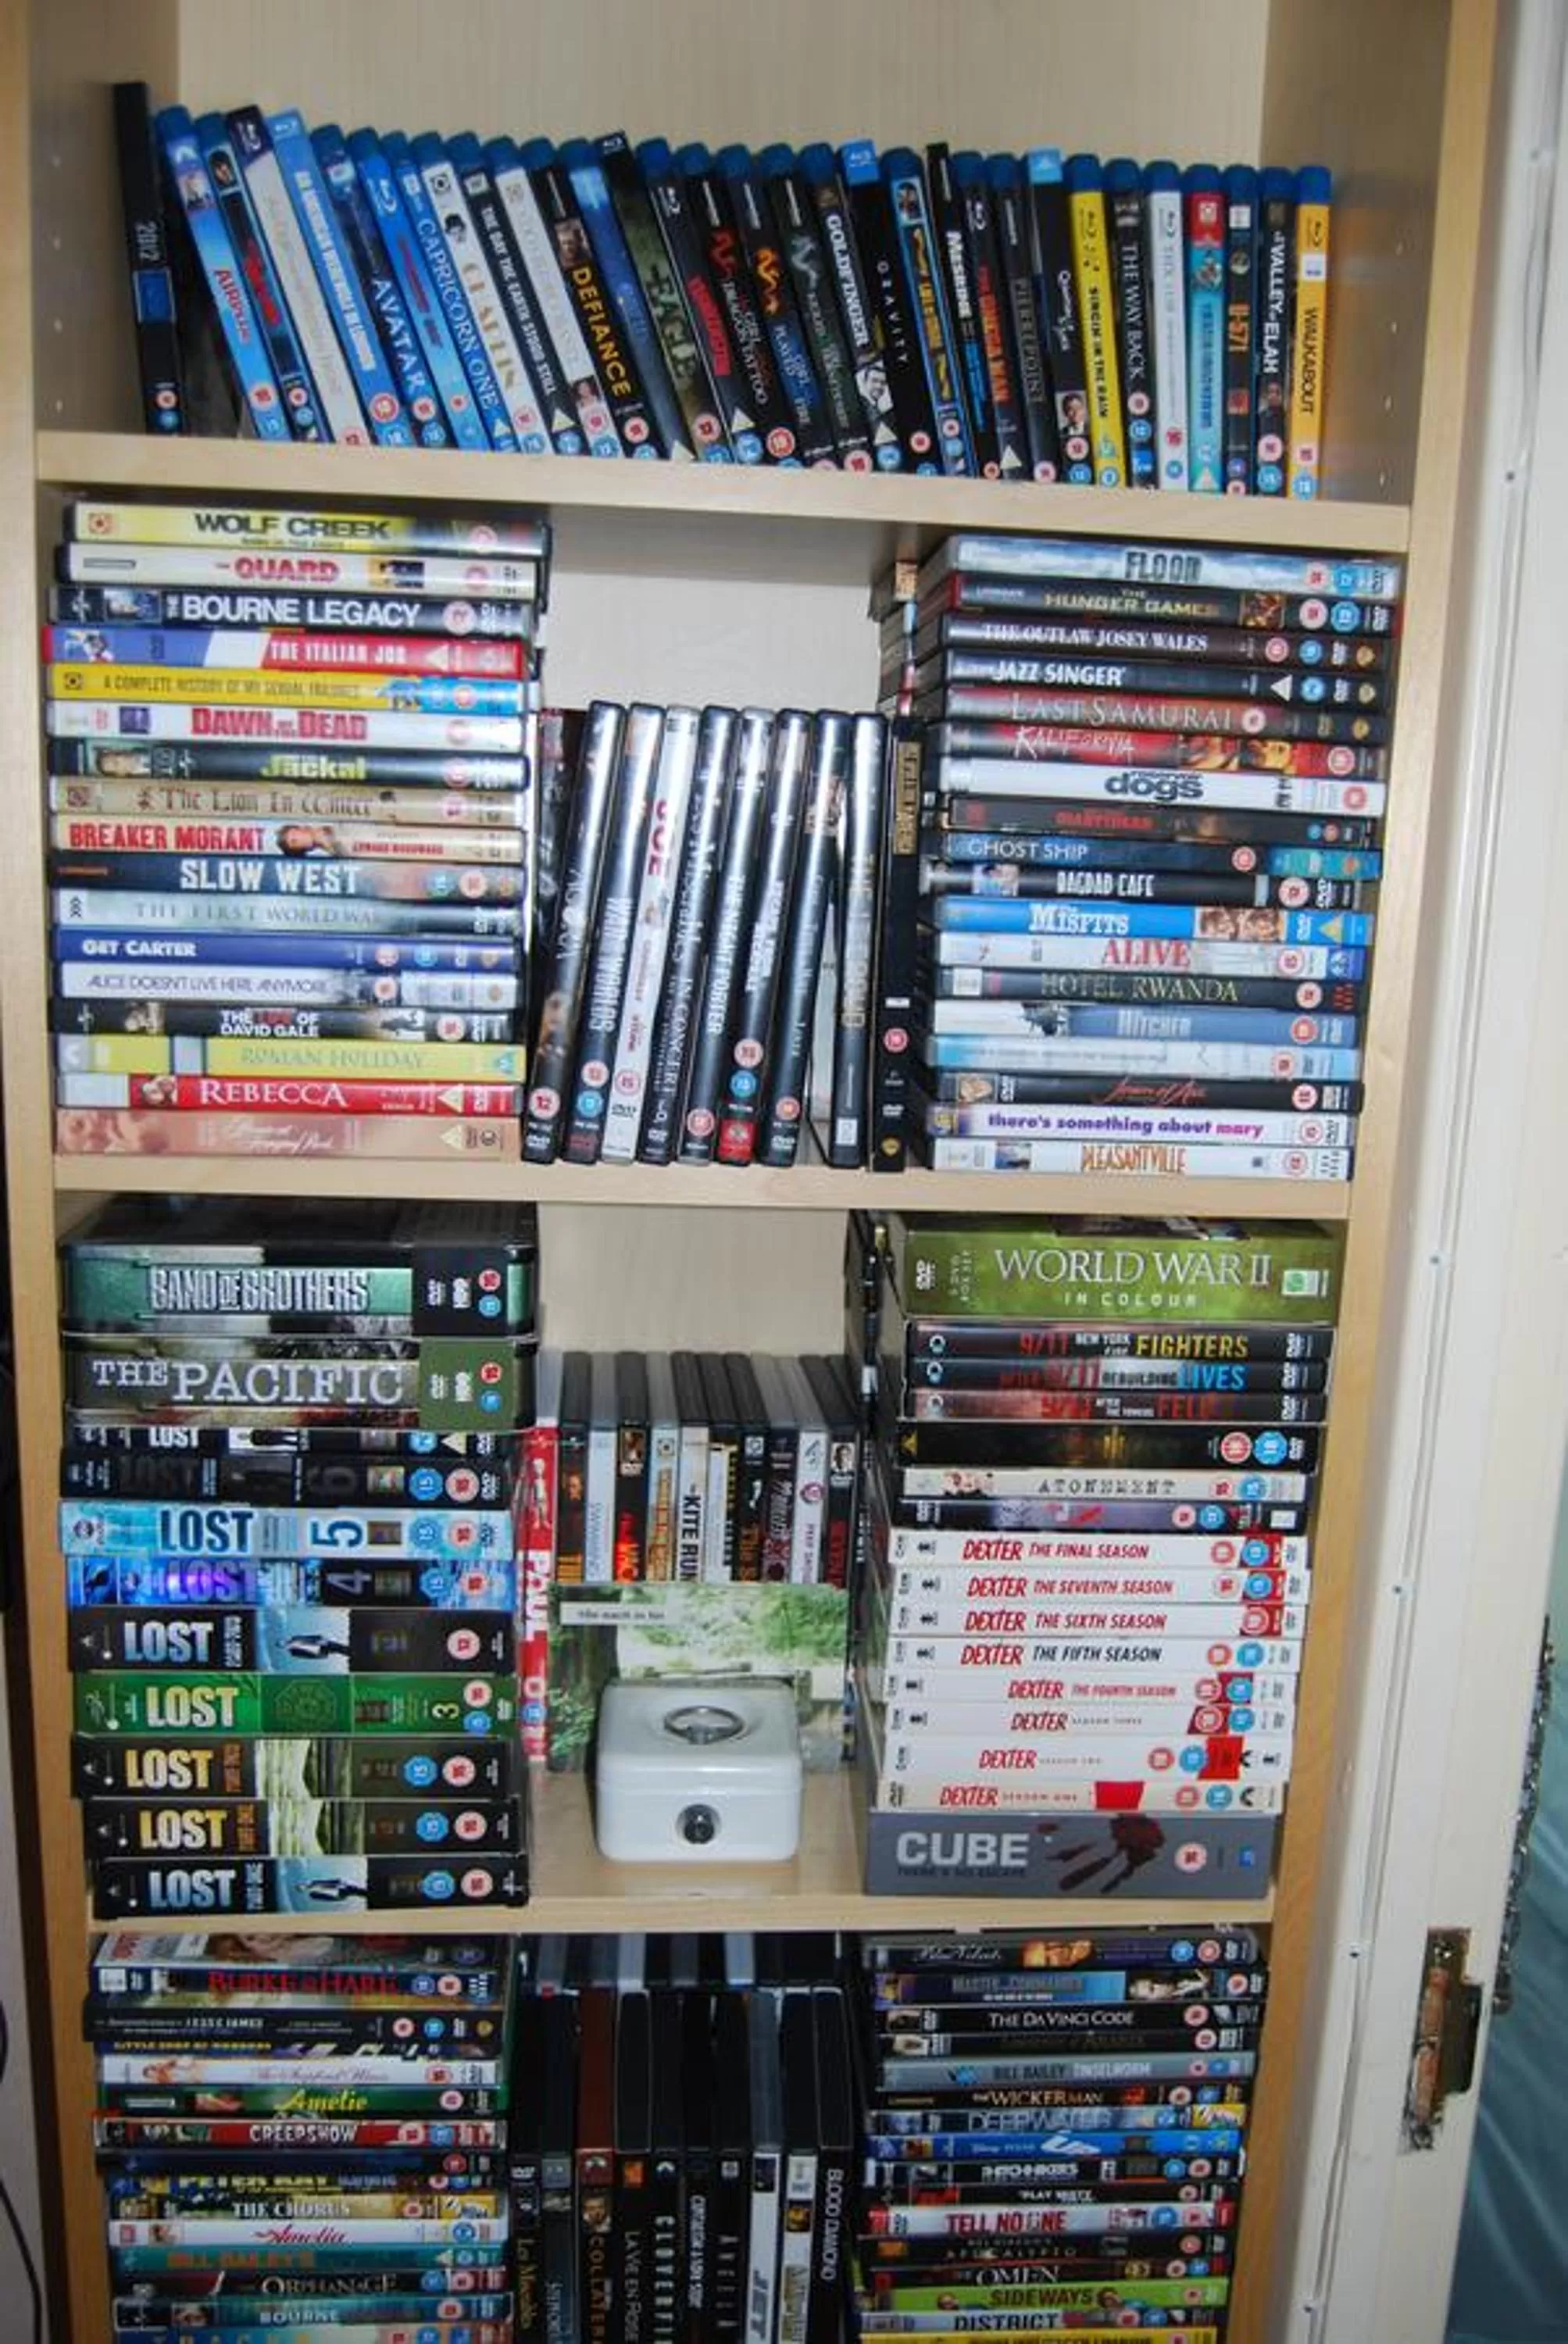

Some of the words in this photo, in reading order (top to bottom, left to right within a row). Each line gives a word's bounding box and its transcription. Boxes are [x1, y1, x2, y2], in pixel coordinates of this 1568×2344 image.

[1123, 245, 1138, 277] THE
[827, 214, 870, 347] GOLDFINGER
[1267, 242, 1286, 313] VALLEY
[416, 219, 479, 352] CAPRICORN
[469, 358, 501, 409] ONE
[877, 261, 908, 363] GRAVITY
[1125, 284, 1142, 325] WAY
[372, 278, 426, 392] AVATAR
[573, 267, 631, 397] DEFIANCE
[1127, 329, 1145, 381] BACK
[1263, 320, 1280, 373] ELAH
[1300, 307, 1320, 415] WALKABOUT
[195, 513, 280, 536] WOLF
[286, 517, 391, 538] CREEK
[235, 557, 340, 583] GUARD
[1125, 548, 1203, 582] FLOOD
[182, 595, 299, 622] BOURNE
[307, 600, 420, 628] LEGACY
[1044, 593, 1138, 613] HUNGER
[1145, 598, 1220, 617] GAMES
[270, 640, 301, 660] THE
[306, 641, 369, 663] ITALIAN
[373, 644, 407, 665] JOB
[1096, 630, 1148, 649] JOSEY
[1152, 632, 1209, 652] WALES
[114, 675, 171, 692] COMPLETE
[991, 661, 1040, 681] JAZZ
[1044, 664, 1123, 686] SINGER
[192, 708, 273, 736] DAWN
[298, 710, 367, 740] DEAD
[1011, 693, 1085, 720] LAST
[1089, 695, 1232, 731] SAMURAI
[261, 753, 366, 780] Jackal
[1105, 771, 1204, 801] dogs
[70, 823, 166, 850] BREAKER
[175, 825, 264, 852] MORANT
[968, 838, 1038, 859] GHOST
[1043, 841, 1090, 861] SHIP
[180, 860, 265, 892] SLOW
[273, 862, 362, 895] WEST
[1056, 870, 1113, 895] BAGDAD
[136, 902, 180, 920] THE
[190, 903, 256, 922] FIRST
[266, 906, 341, 924] WORLD
[83, 940, 121, 956] GET
[126, 940, 196, 958] CARTER
[1101, 938, 1192, 968] ALIVE
[86, 975, 125, 991] ALICE
[191, 976, 216, 992] LIVE
[218, 977, 253, 992] HERE
[1040, 972, 1123, 999] HOTEL
[1132, 974, 1241, 1002] RWANDA
[705, 967, 735, 1035] PORTER
[221, 1010, 249, 1024] THE
[296, 1012, 319, 1025] OF
[221, 1024, 270, 1038] DAVID
[275, 1024, 319, 1038] GALE
[329, 1049, 426, 1068] HOLIDAY
[664, 999, 691, 1095] CONCERT
[199, 1083, 348, 1108] REBECCA
[988, 1114, 1052, 1130] there's
[1056, 1115, 1154, 1135] something
[1158, 1117, 1213, 1134] about
[1216, 1121, 1264, 1139] mary
[1080, 1144, 1185, 1172] PLEASANTVILLE
[995, 1249, 1145, 1284] WORLD
[1155, 1251, 1241, 1284] WAR
[1250, 1254, 1272, 1284] II
[151, 1270, 217, 1311] BAND
[240, 1270, 370, 1313] BROTHERS
[1065, 1292, 1089, 1304] IN
[1102, 1292, 1199, 1307] COLOUR
[1076, 1333, 1099, 1345] NEW
[1103, 1333, 1130, 1345] YORK
[1136, 1335, 1248, 1358] FIGHTERS
[93, 1360, 169, 1387] THE
[171, 1362, 405, 1405] PACIFIC
[1177, 1364, 1246, 1390] LIVES
[148, 1427, 201, 1449] LOST
[1038, 1478, 1176, 1497] ATONEMENT
[681, 1495, 702, 1540] KITE
[161, 1510, 254, 1553] LOST
[313, 1519, 363, 1547] 5
[962, 1540, 1022, 1561] DEXTER
[1029, 1542, 1052, 1558] THE
[1055, 1543, 1093, 1559] FINAL
[1095, 1543, 1149, 1560] SEASON
[166, 1559, 256, 1603] LOST
[326, 1568, 373, 1595] 4
[966, 1575, 1027, 1598] DEXTER
[1033, 1580, 1055, 1594] THE
[1058, 1580, 1120, 1595] SEVENTH
[1122, 1580, 1173, 1595] SEASON
[964, 1610, 1027, 1633] DEXTER
[1034, 1613, 1058, 1629] THE
[1061, 1614, 1107, 1630] SIXTH
[1110, 1614, 1168, 1631] SEASON
[123, 1621, 214, 1662] LOST
[960, 1644, 1023, 1667] DEXTER
[1032, 1646, 1057, 1662] THE
[1061, 1647, 1102, 1663] FIFTH
[1105, 1647, 1162, 1663] SEASON
[1008, 1680, 1064, 1700] DEXTER
[1136, 1685, 1177, 1697] SEASON
[146, 1686, 238, 1728] LOST
[1010, 1711, 1068, 1731] DEXTER
[125, 1749, 214, 1789] LOST
[978, 1749, 1037, 1771] DEXTER
[940, 1786, 999, 1807] DEXTER
[138, 1809, 228, 1849] LOST
[897, 1831, 1030, 1867] CUBE
[148, 1870, 237, 1909] LOST
[990, 2011, 1018, 2027] THE
[1091, 2010, 1134, 2025] CODE
[249, 2124, 357, 2142] CREEPSHOW
[945, 2211, 994, 2233] TELL
[996, 2210, 1025, 2233] NO
[989, 2289, 1093, 2307] SIDEWAYS
[954, 2313, 1059, 2331] DISTRICT
